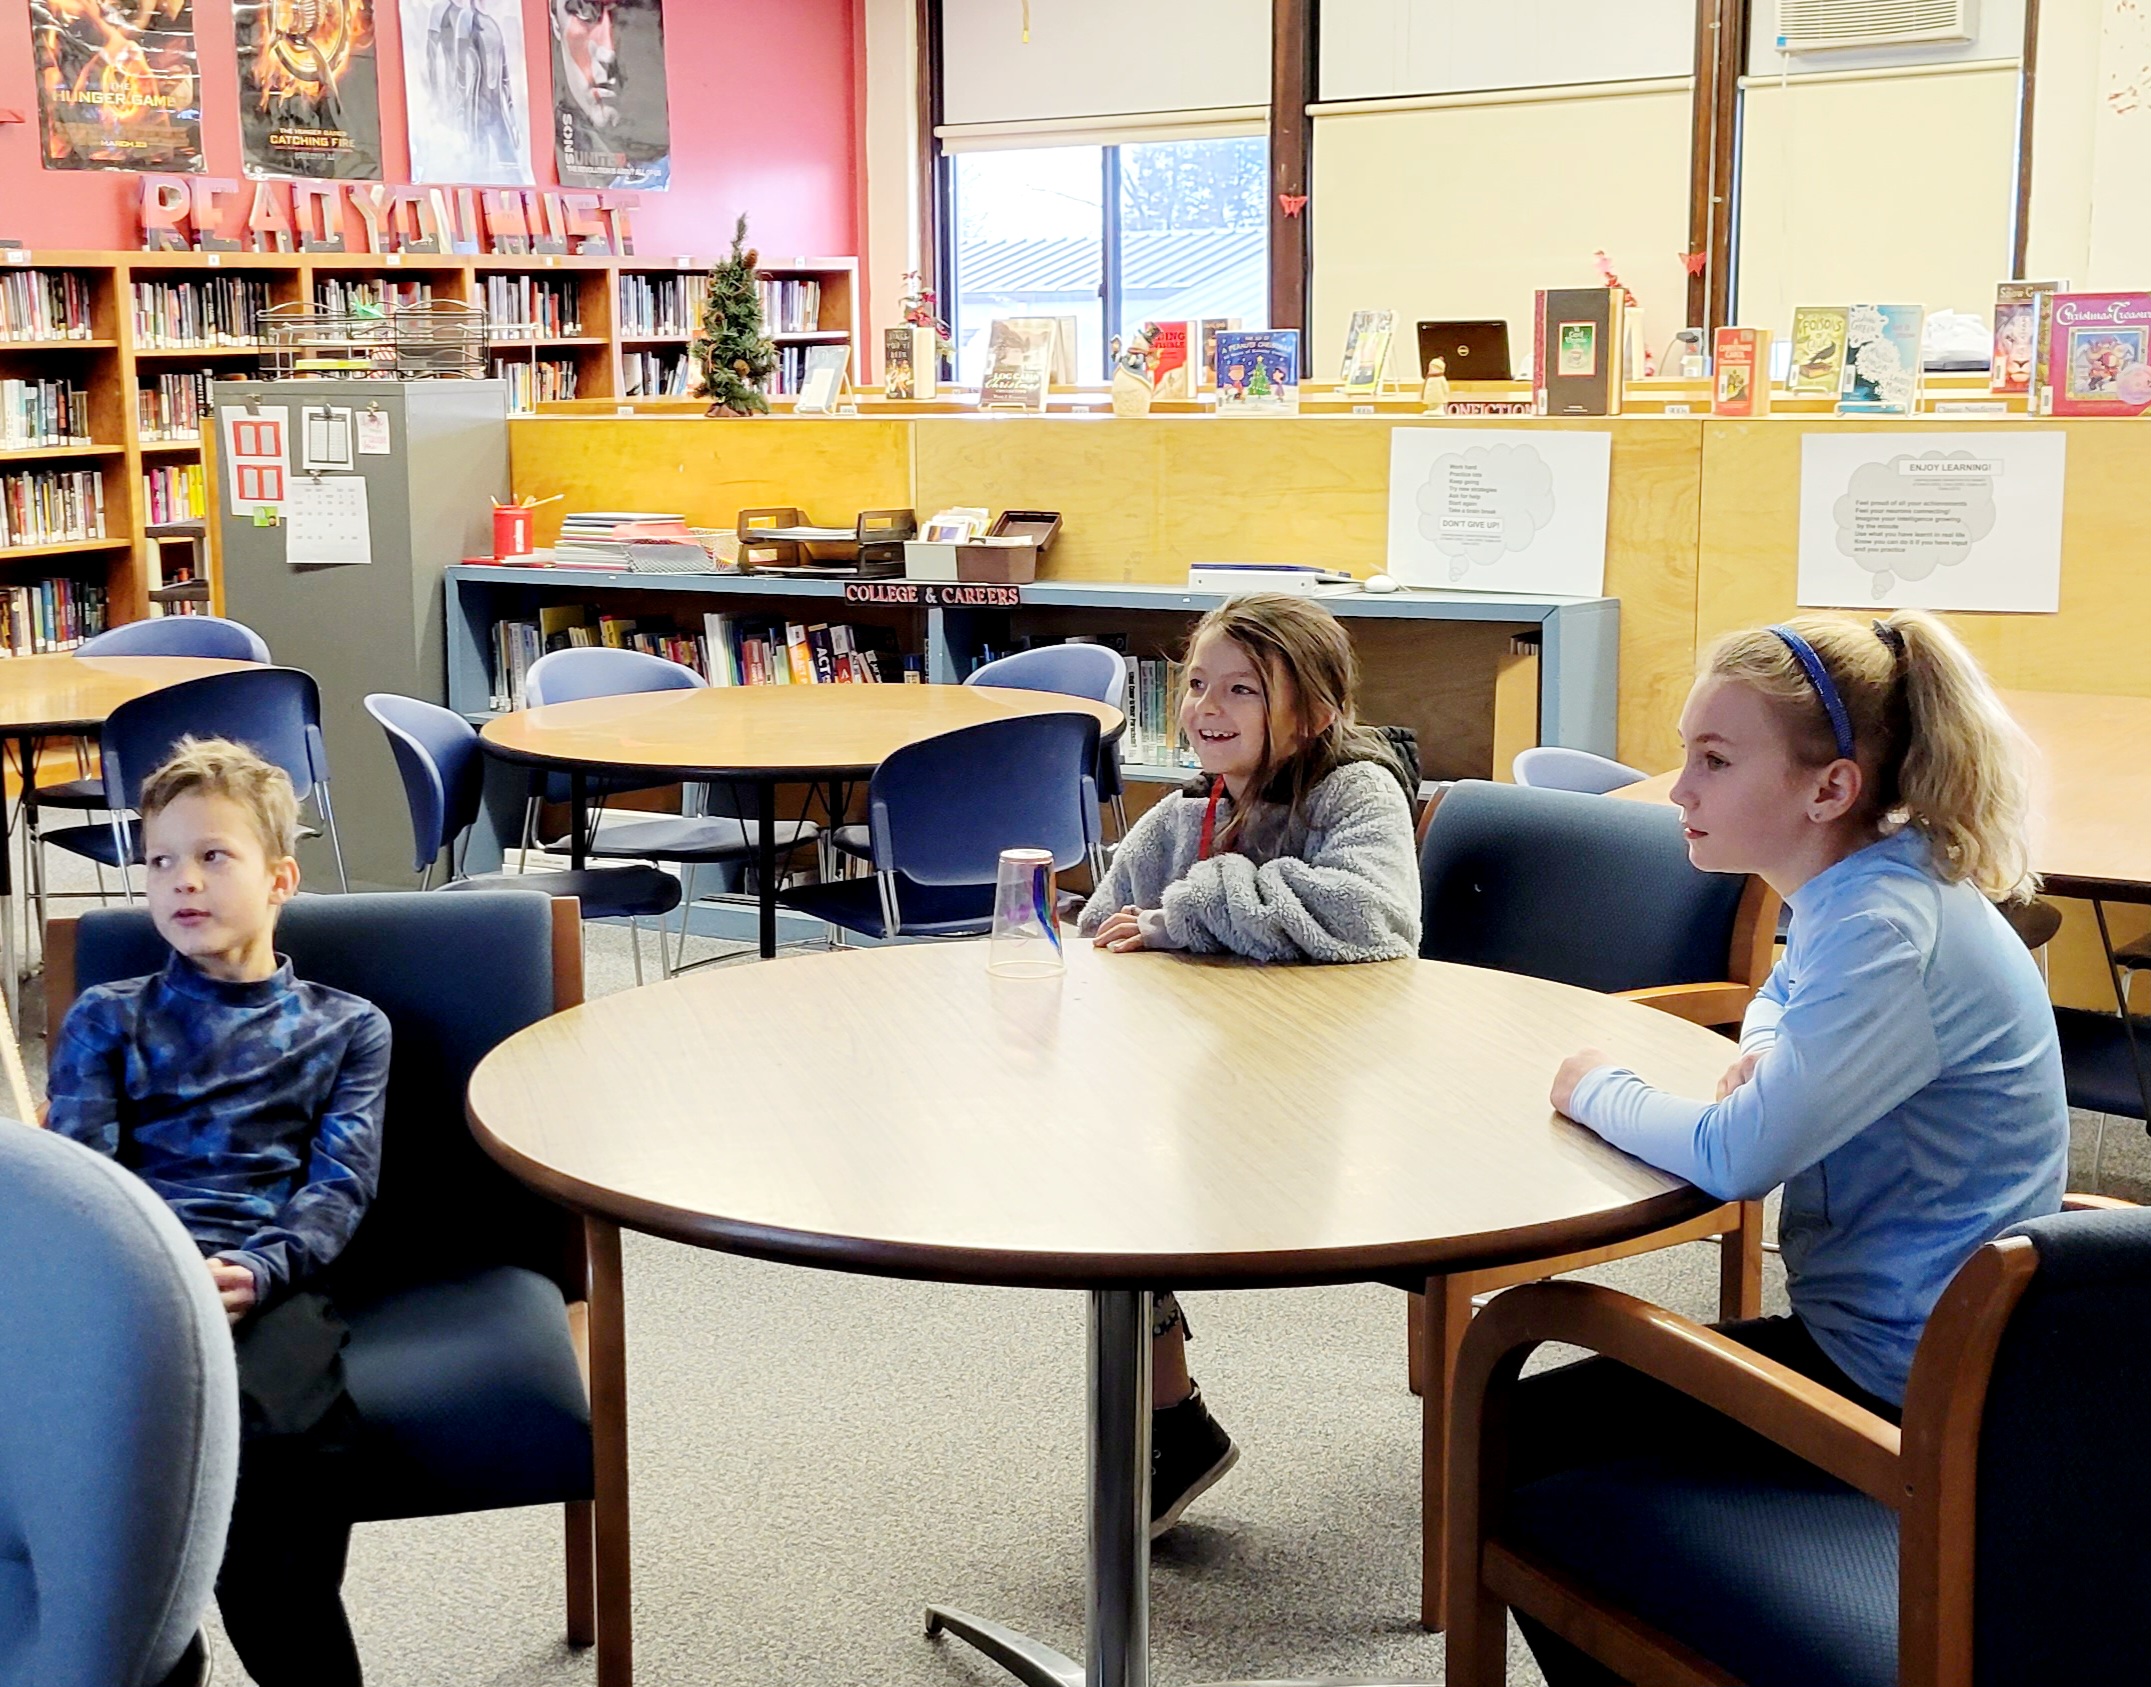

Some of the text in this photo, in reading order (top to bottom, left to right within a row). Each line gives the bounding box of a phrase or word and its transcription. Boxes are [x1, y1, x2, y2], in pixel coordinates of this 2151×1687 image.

[110, 82, 131, 91] THE
[53, 90, 126, 105] HUNGER
[270, 135, 356, 148] CATCHING FIRE
[2108, 301, 2151, 324] Treasur
[1444, 403, 1533, 415] ONFICTION
[1909, 463, 1992, 472] ENJOY LEARNING!
[846, 585, 1019, 605] COLLEGE & CAREERS
[816, 647, 832, 676] ACT
